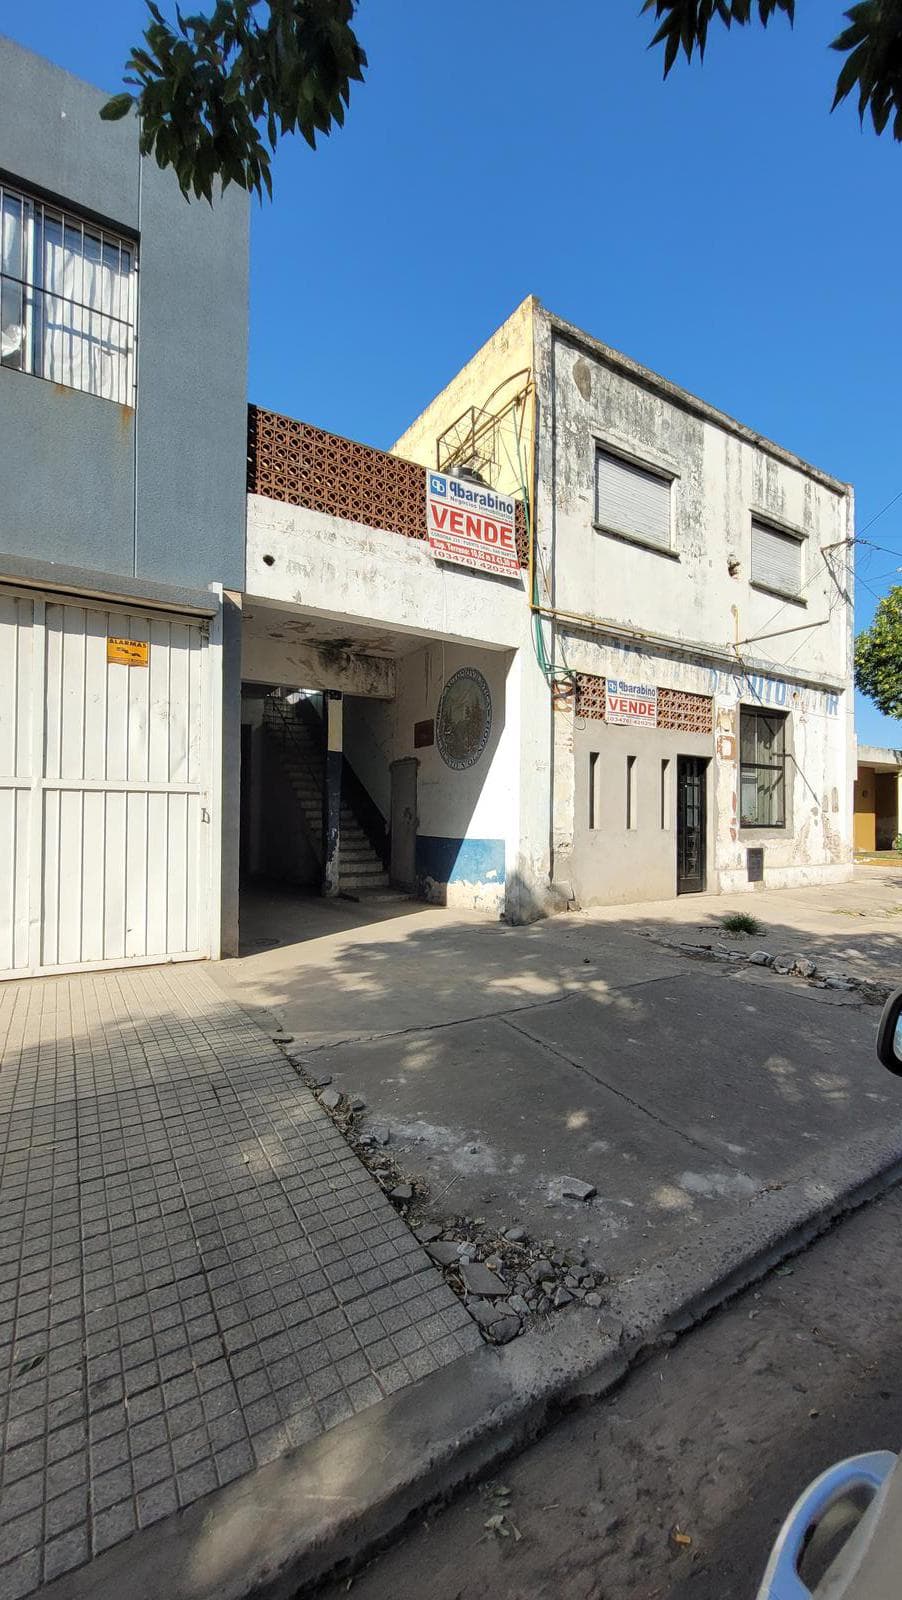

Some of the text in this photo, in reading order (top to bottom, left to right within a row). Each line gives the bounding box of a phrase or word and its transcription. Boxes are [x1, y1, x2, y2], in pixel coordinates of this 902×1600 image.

[431, 504, 514, 549] VENDE
[434, 550, 477, 566] (03476)
[109, 638, 147, 649] ALARMAS
[609, 698, 655, 716] VENDE
